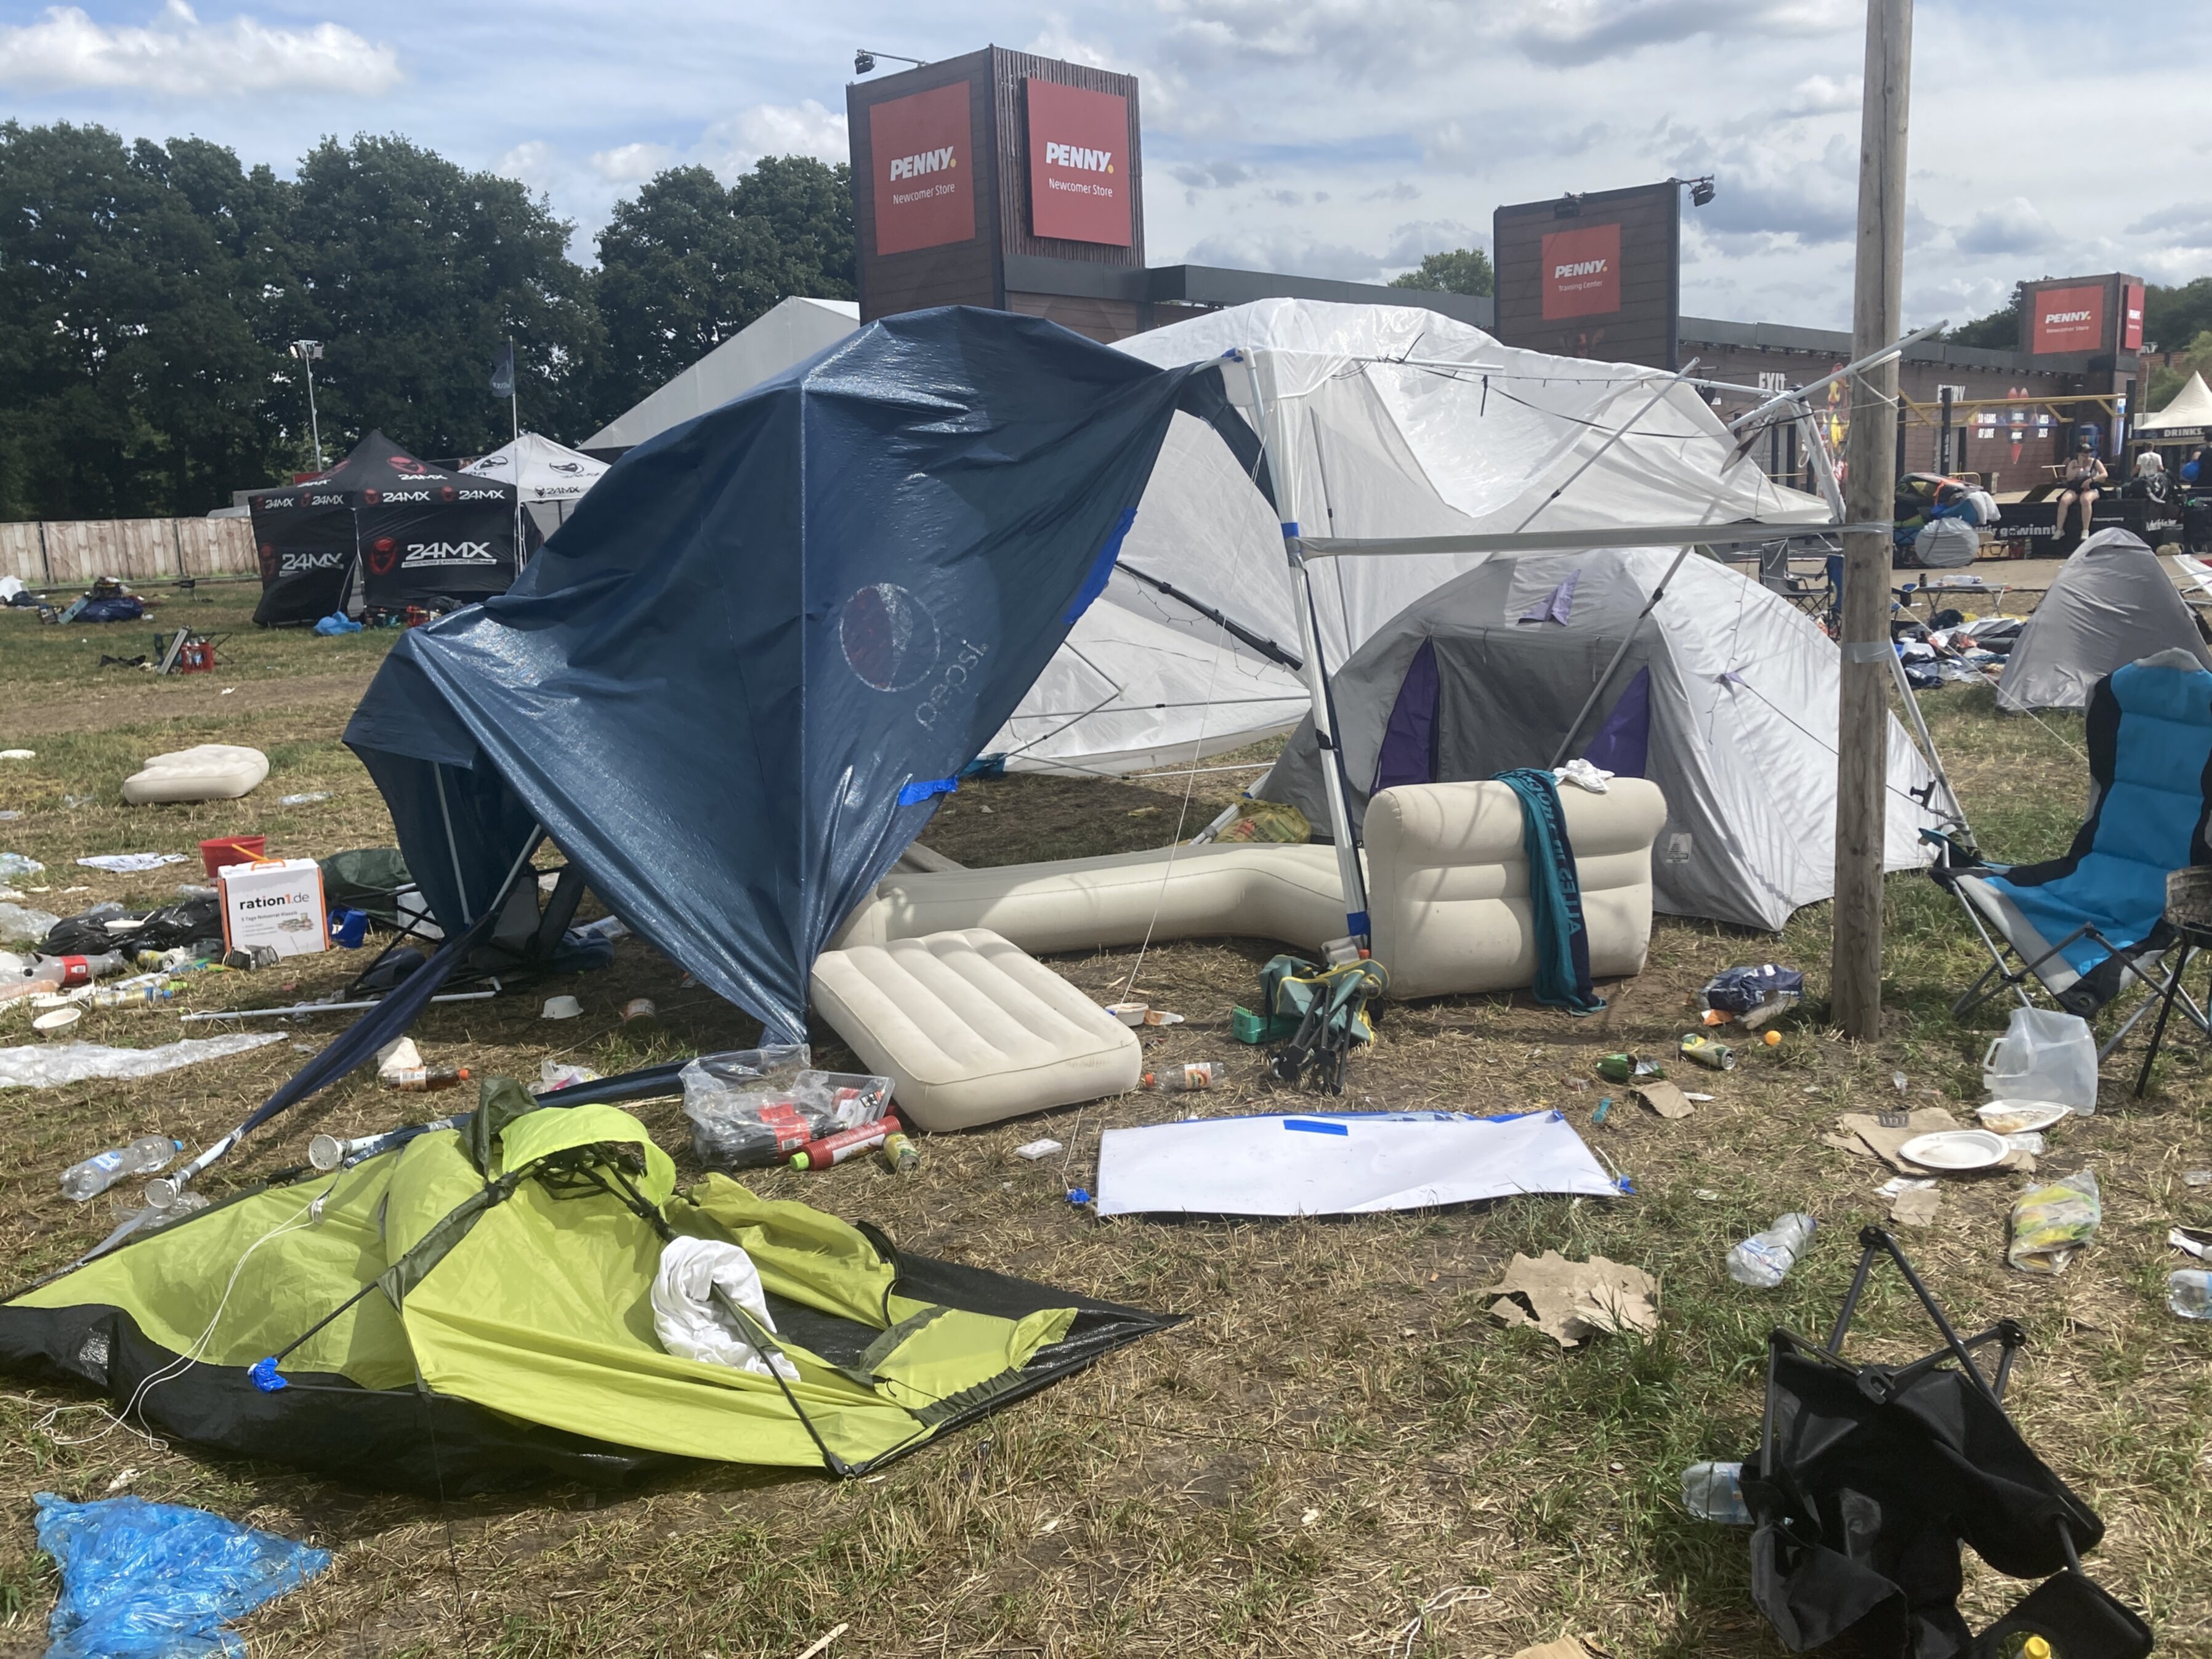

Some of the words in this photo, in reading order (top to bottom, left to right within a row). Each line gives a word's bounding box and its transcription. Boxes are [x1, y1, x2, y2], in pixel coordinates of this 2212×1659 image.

[890, 145, 956, 181] PENNY.
[1046, 142, 1114, 174] PENNY.
[893, 188, 934, 204] Newcomer
[935, 182, 955, 195] Store
[1049, 178, 1091, 194] Newcomer
[1092, 185, 1113, 197] Store
[1555, 259, 1608, 278] PENNY.
[1559, 283, 1582, 291] Training
[1583, 280, 1603, 289] Center
[2046, 311, 2091, 323] PENNY.
[1759, 371, 1785, 398] EXIT
[382, 491, 431, 503] 24MX
[459, 490, 506, 500] 24MX
[546, 486, 580, 494] 24MX
[265, 498, 294, 509] 24MX
[312, 494, 344, 506] 24MX
[405, 541, 493, 560] 24MX
[240, 892, 309, 910] ration1.de
